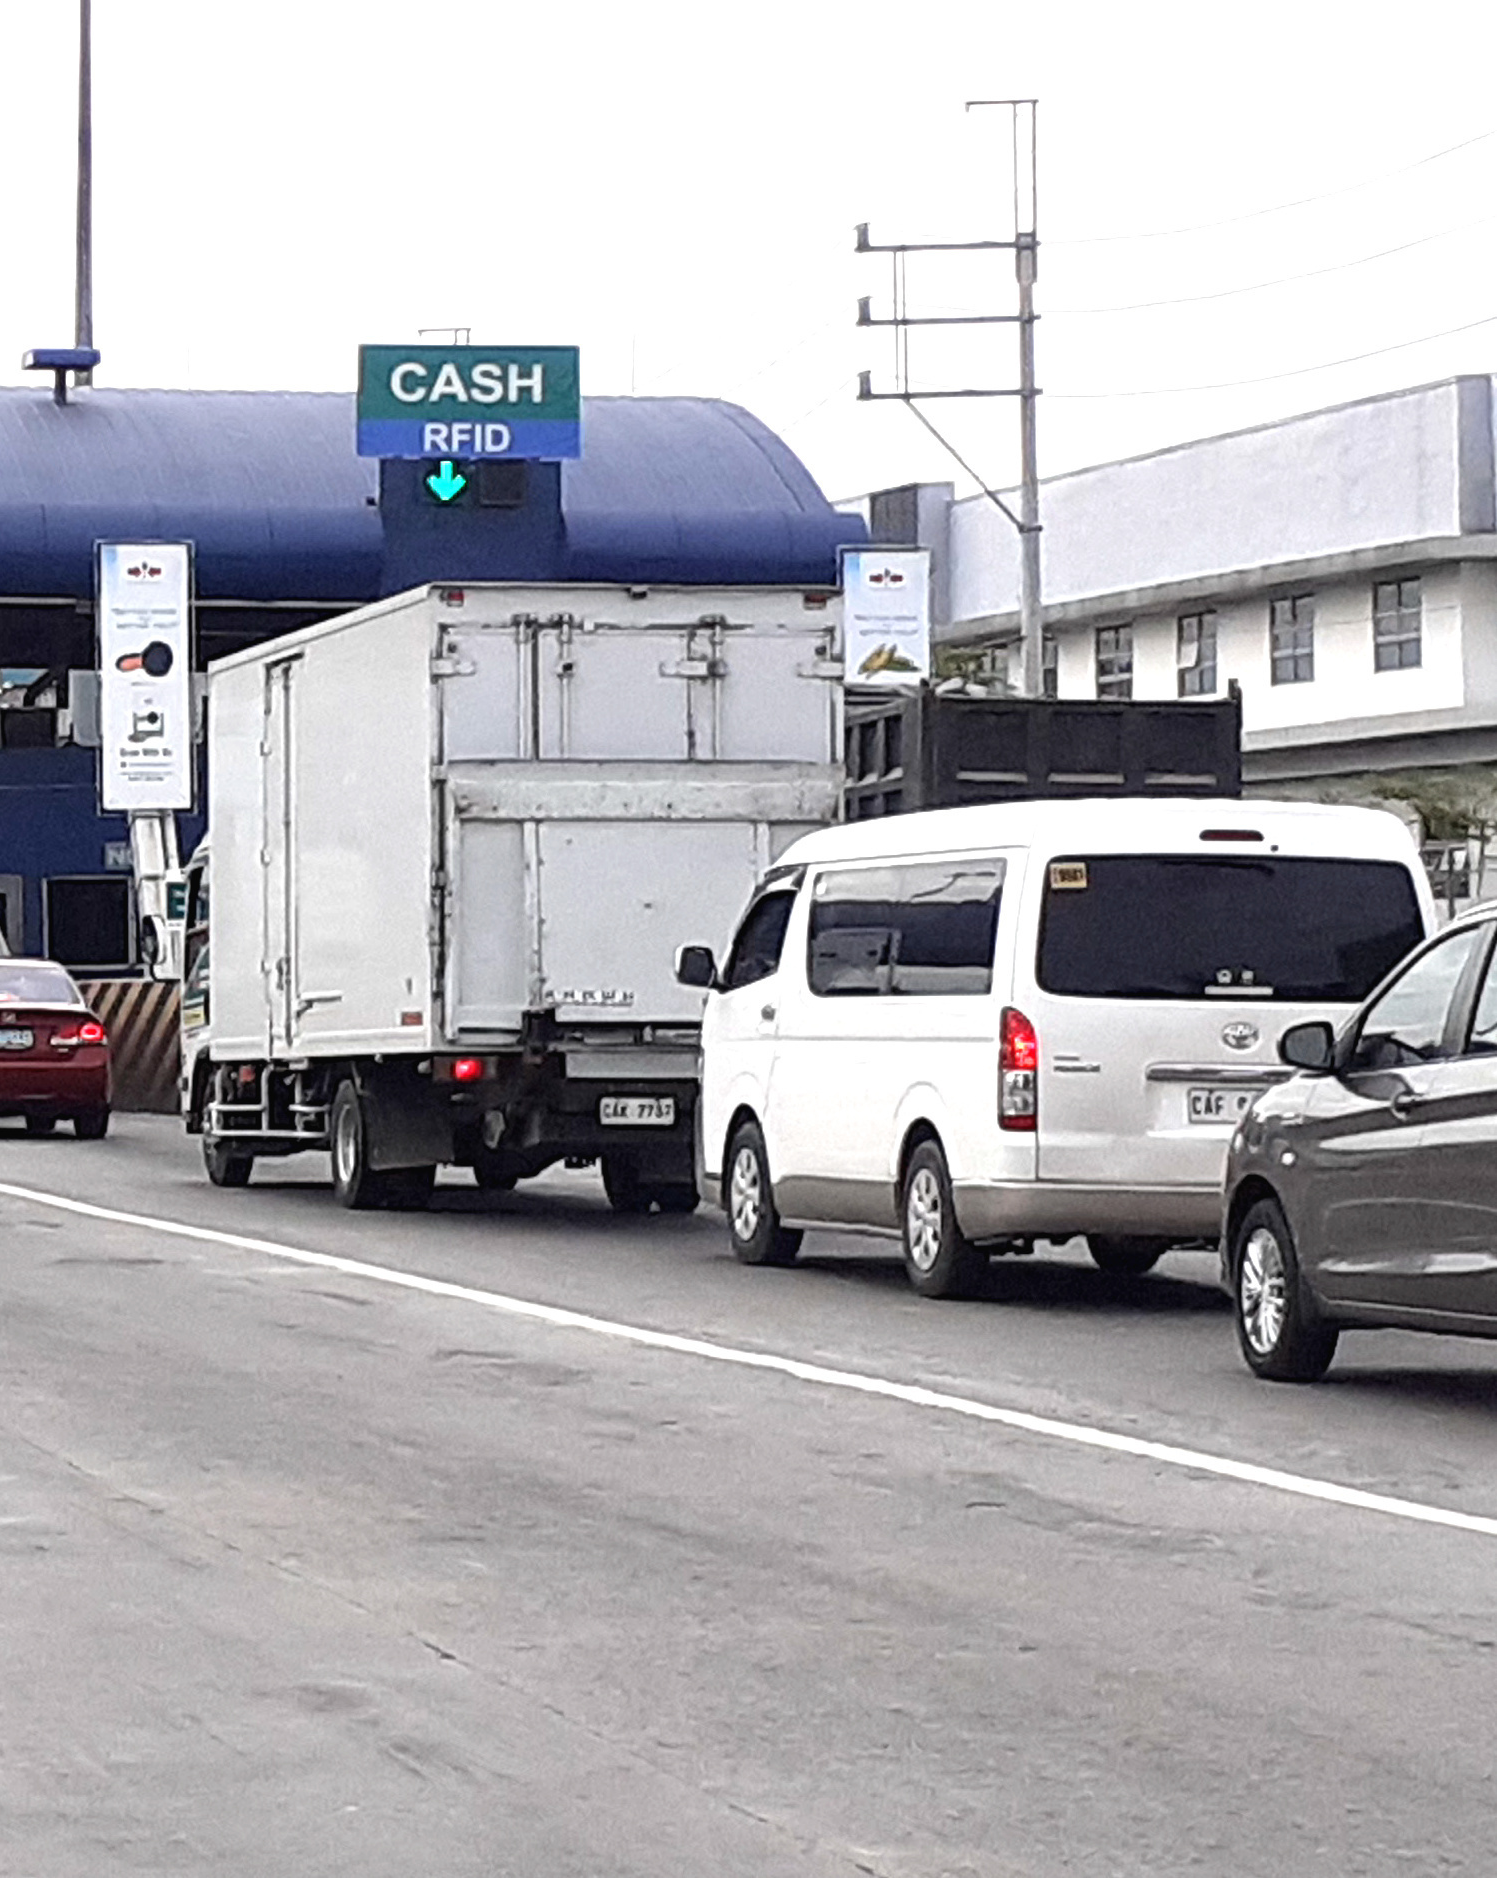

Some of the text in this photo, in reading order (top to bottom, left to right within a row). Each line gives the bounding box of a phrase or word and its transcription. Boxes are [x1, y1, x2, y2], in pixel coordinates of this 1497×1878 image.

[390, 362, 543, 403] CASH
[423, 422, 511, 453] RFID
[1191, 1094, 1224, 1116] CAF
